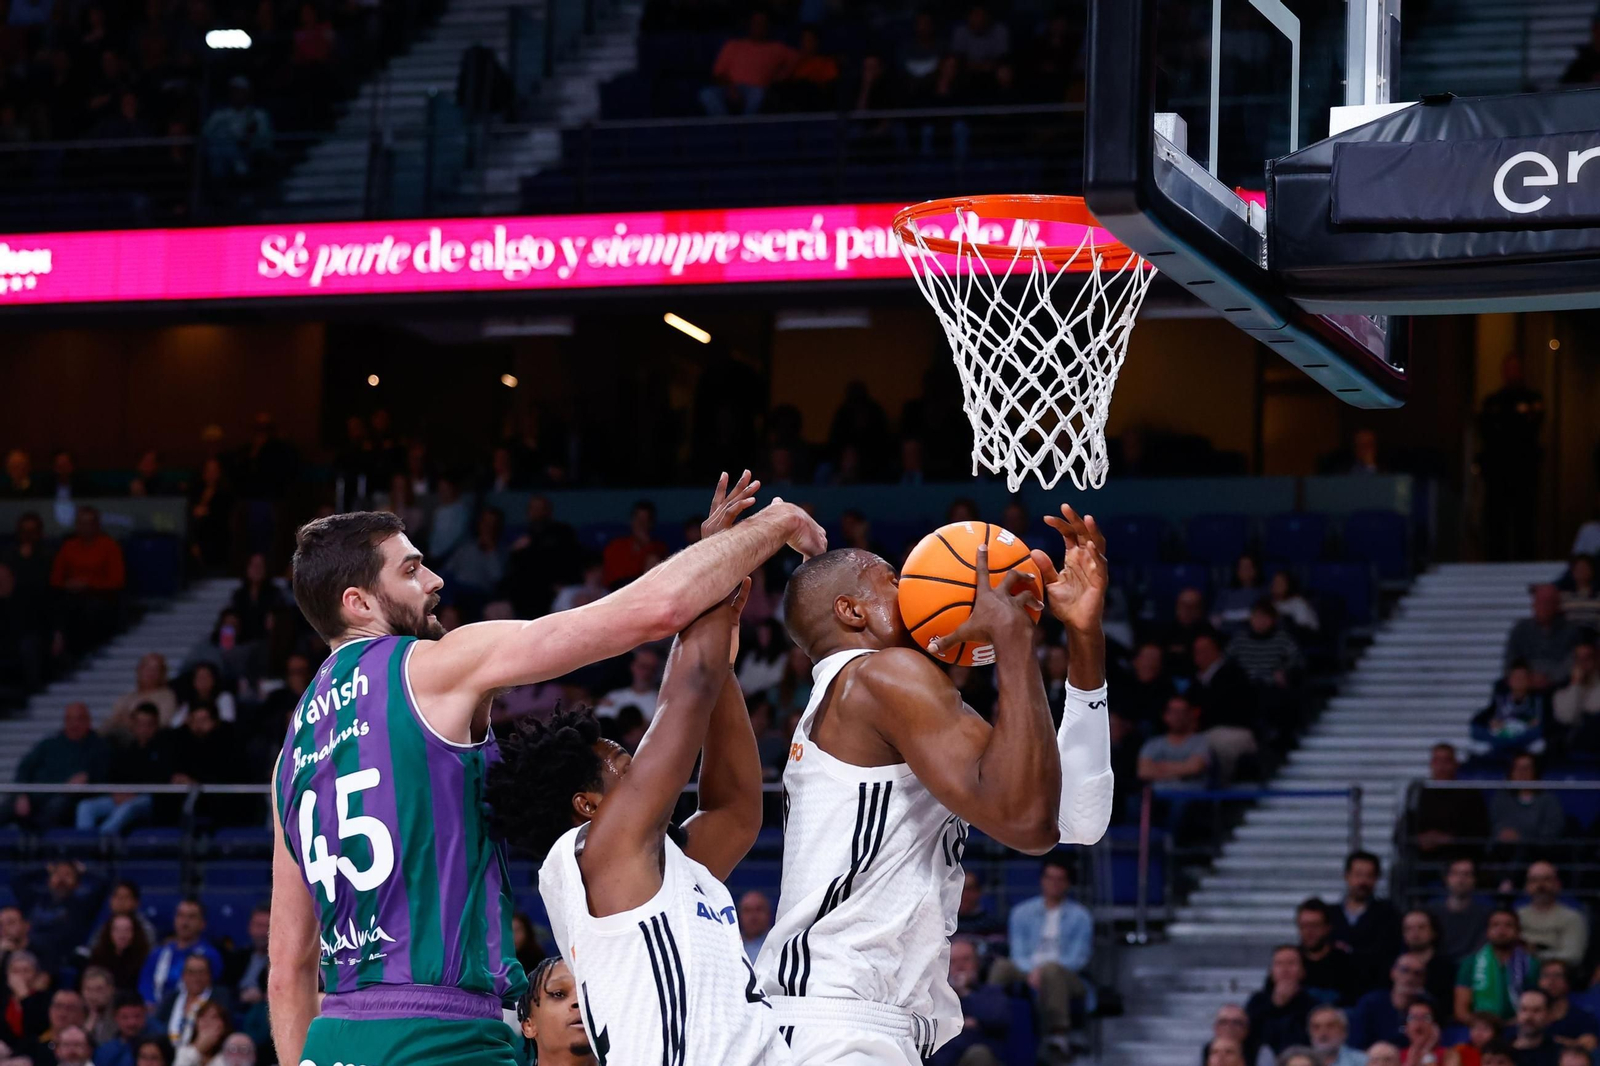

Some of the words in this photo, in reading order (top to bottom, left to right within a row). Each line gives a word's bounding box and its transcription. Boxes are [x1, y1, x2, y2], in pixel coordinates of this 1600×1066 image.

[258, 232, 310, 278] Sé
[309, 235, 411, 287] parte
[413, 227, 466, 273] de
[469, 225, 555, 281] algo
[557, 236, 588, 280] y
[587, 222, 741, 276] siempre
[740, 213, 830, 262] será
[298, 767, 395, 903] 45
